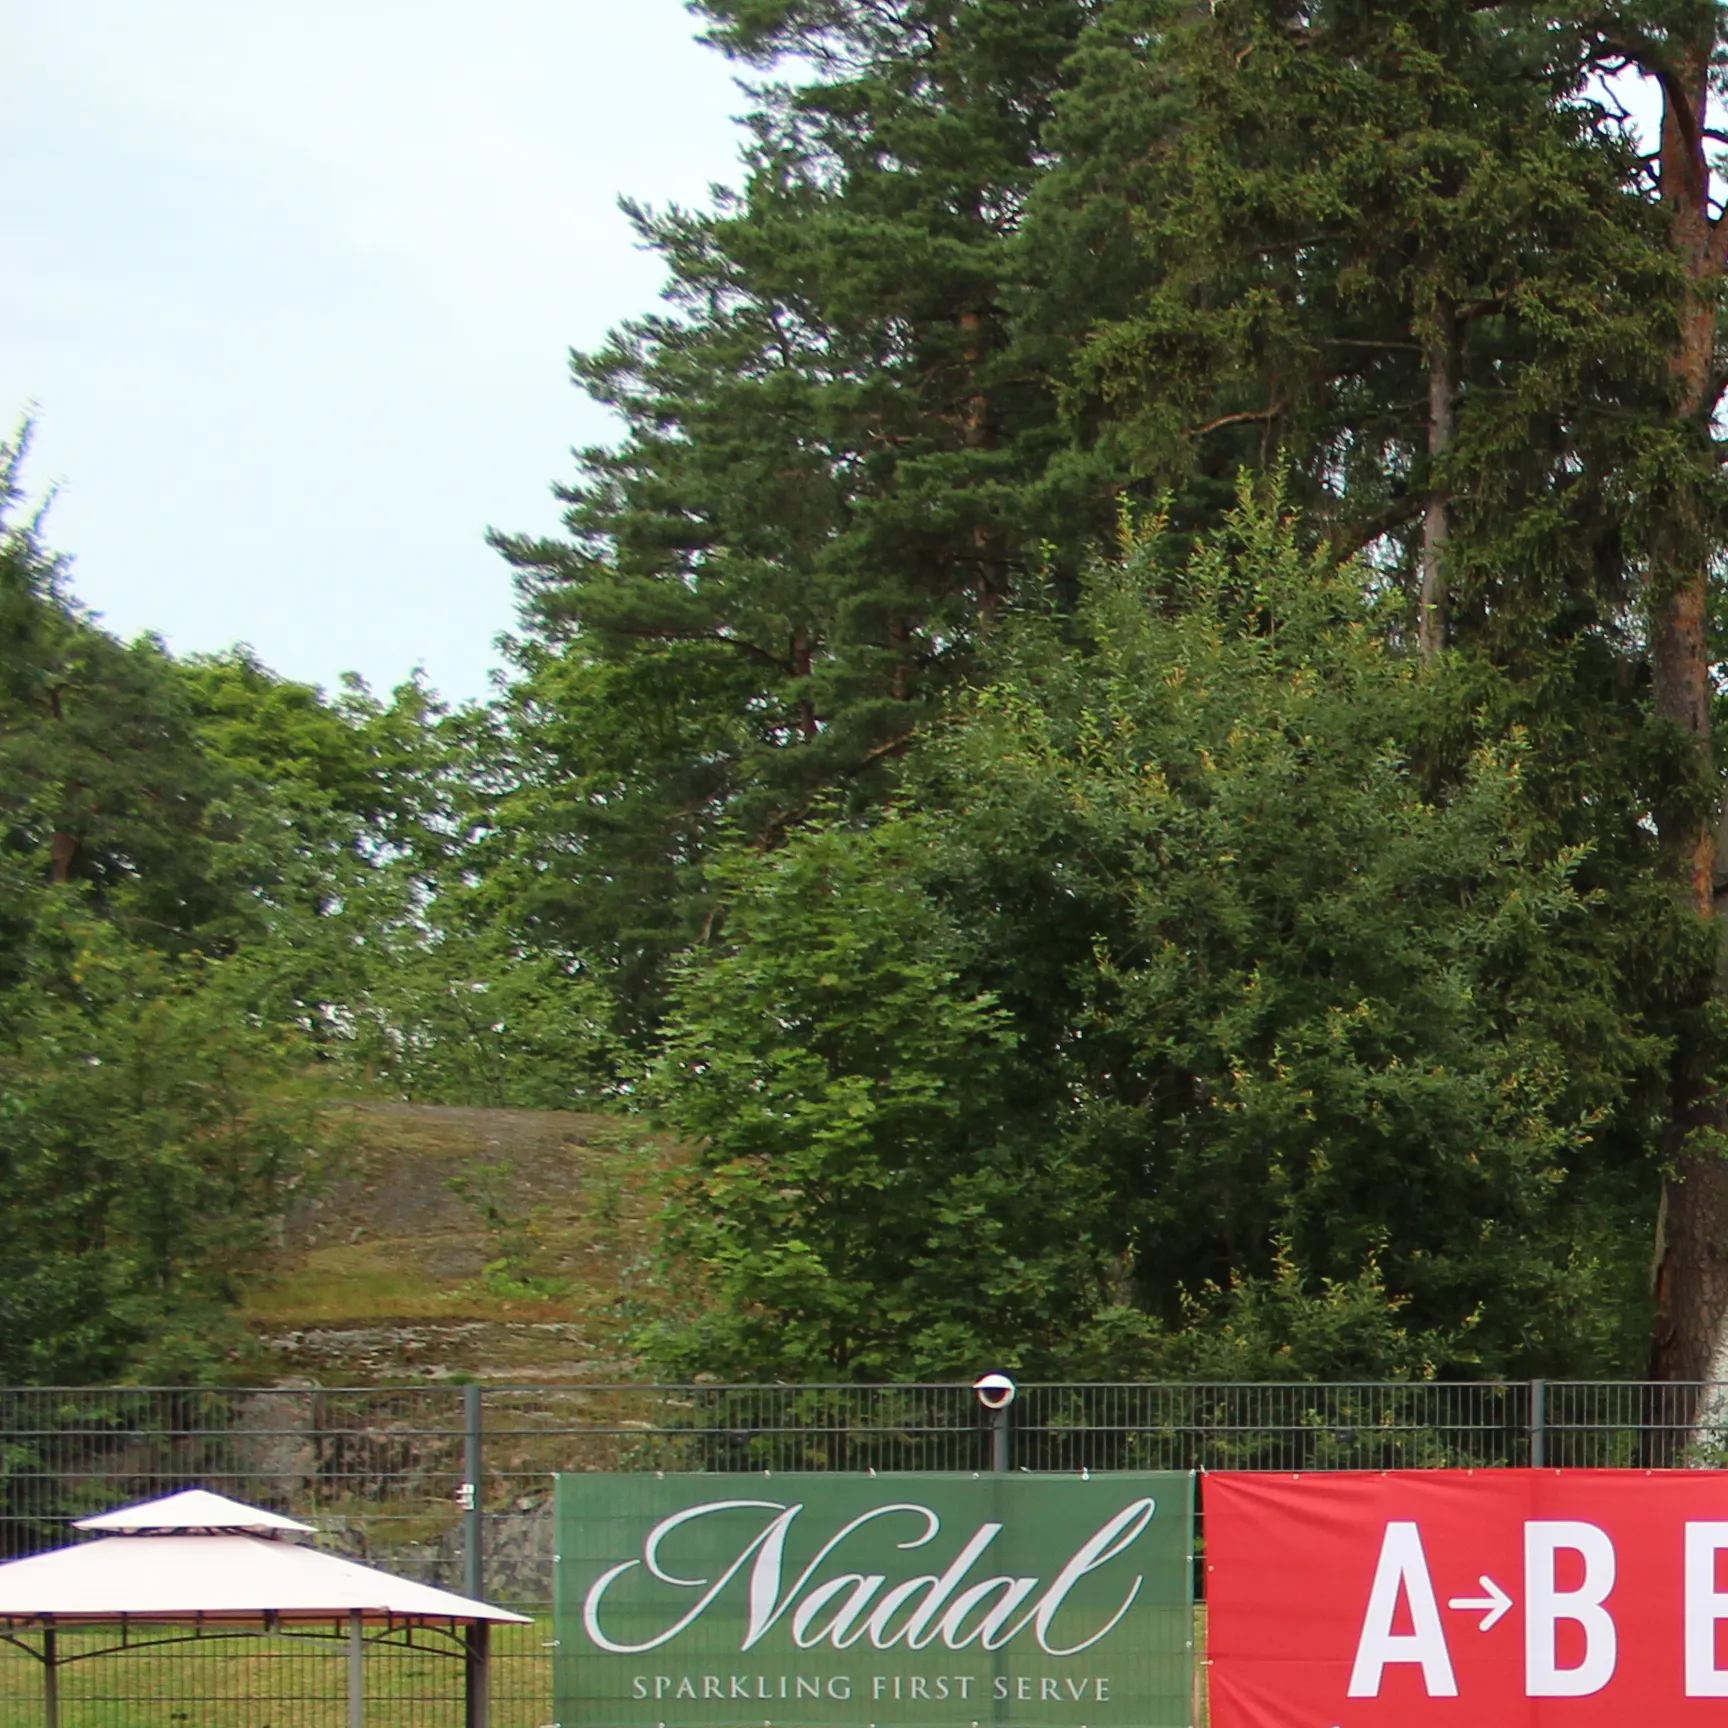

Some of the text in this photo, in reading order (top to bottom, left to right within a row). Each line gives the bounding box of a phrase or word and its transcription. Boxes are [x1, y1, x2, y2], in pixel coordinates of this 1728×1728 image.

[583, 1498, 1154, 1656] Nadal
[1347, 1521, 1457, 1697] A
[1524, 1521, 1616, 1697] B
[634, 1676, 1109, 1701] SPARKLING FIRST SERVE
